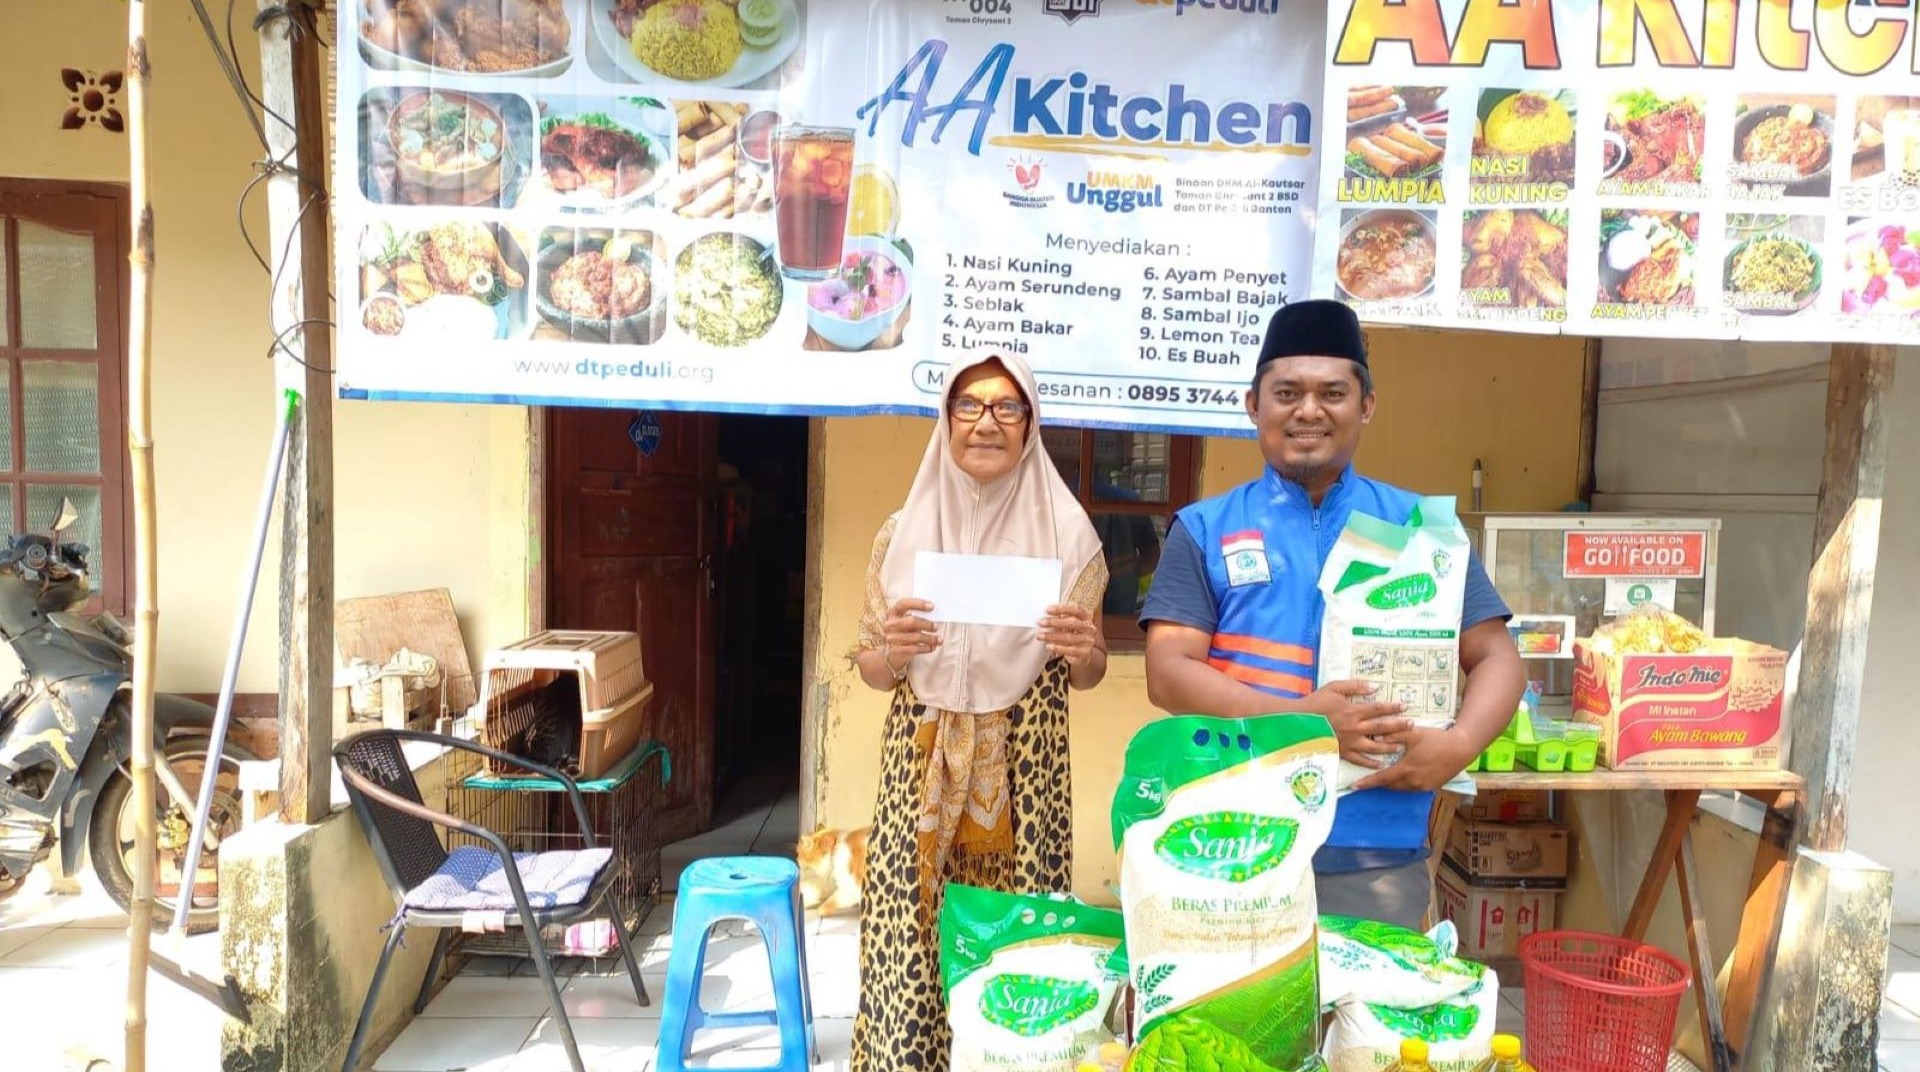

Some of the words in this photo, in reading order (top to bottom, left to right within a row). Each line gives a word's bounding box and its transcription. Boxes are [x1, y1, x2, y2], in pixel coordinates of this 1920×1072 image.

[1596, 0, 1920, 76] Kitc
[1012, 71, 1312, 145] Kitchen
[1470, 155, 1528, 177] NASI
[1087, 171, 1154, 189] UMKM
[1175, 177, 1214, 188] Binaan
[1337, 177, 1446, 204] LUMPIA
[1596, 179, 1649, 196] AYAM
[1067, 182, 1163, 213] Unggul
[1174, 190, 1212, 200] Taman
[1268, 192, 1275, 201] 2
[1277, 192, 1299, 201] BSD
[1469, 181, 1569, 205] KUNING
[1173, 202, 1195, 212] dan
[1251, 204, 1291, 214] Banten
[1046, 232, 1180, 256] Menyediakan
[946, 253, 957, 268] 1.
[963, 254, 1001, 270] Nasi
[1008, 257, 1073, 278] Kuning
[1144, 266, 1159, 281] 6.
[1164, 267, 1216, 284] Ayam
[1223, 268, 1287, 287] Penyet
[944, 274, 959, 288] 2.
[965, 276, 1016, 293] Ayam
[1022, 279, 1121, 301] Serundeng
[1142, 286, 1156, 300] 7.
[1162, 287, 1230, 304] Sambal
[1236, 290, 1288, 308] Bajak
[1458, 287, 1511, 304] AYAM
[943, 294, 957, 308] 3.
[964, 296, 1024, 313] Seblak
[1721, 291, 1798, 310] SAMBAL
[1141, 307, 1156, 321] 8.
[1162, 307, 1230, 324] Sambal
[1236, 310, 1260, 328] Ijo
[1590, 303, 1642, 320] AYAM
[943, 313, 959, 328] 4.
[963, 316, 1015, 334] Ayam
[1021, 319, 1074, 336] Bakar
[942, 333, 956, 348] 5.
[1139, 327, 1155, 340] 9.
[1161, 327, 1224, 344] Lemon
[1229, 330, 1260, 346] Tea
[1138, 346, 1161, 361] 10.
[1167, 347, 1188, 362] Es
[1193, 349, 1240, 365] Buah
[513, 357, 714, 384] www.dtpeduli.org
[1036, 382, 1111, 400] esanan
[1128, 384, 1180, 402] 0895
[1186, 387, 1239, 405] 3744
[1584, 536, 1609, 545] NOW
[1610, 536, 1665, 545] AVAILABLE
[1668, 536, 1684, 545] ON
[1629, 548, 1686, 566] FOOD
[1382, 579, 1429, 602] Sania
[1663, 706, 1697, 716] Instan
[1650, 729, 1688, 745] Ayam
[1690, 729, 1747, 745] Bawang
[1184, 826, 1274, 861] Sania
[1171, 896, 1218, 912] BERAS
[997, 984, 1073, 1017] Sania
